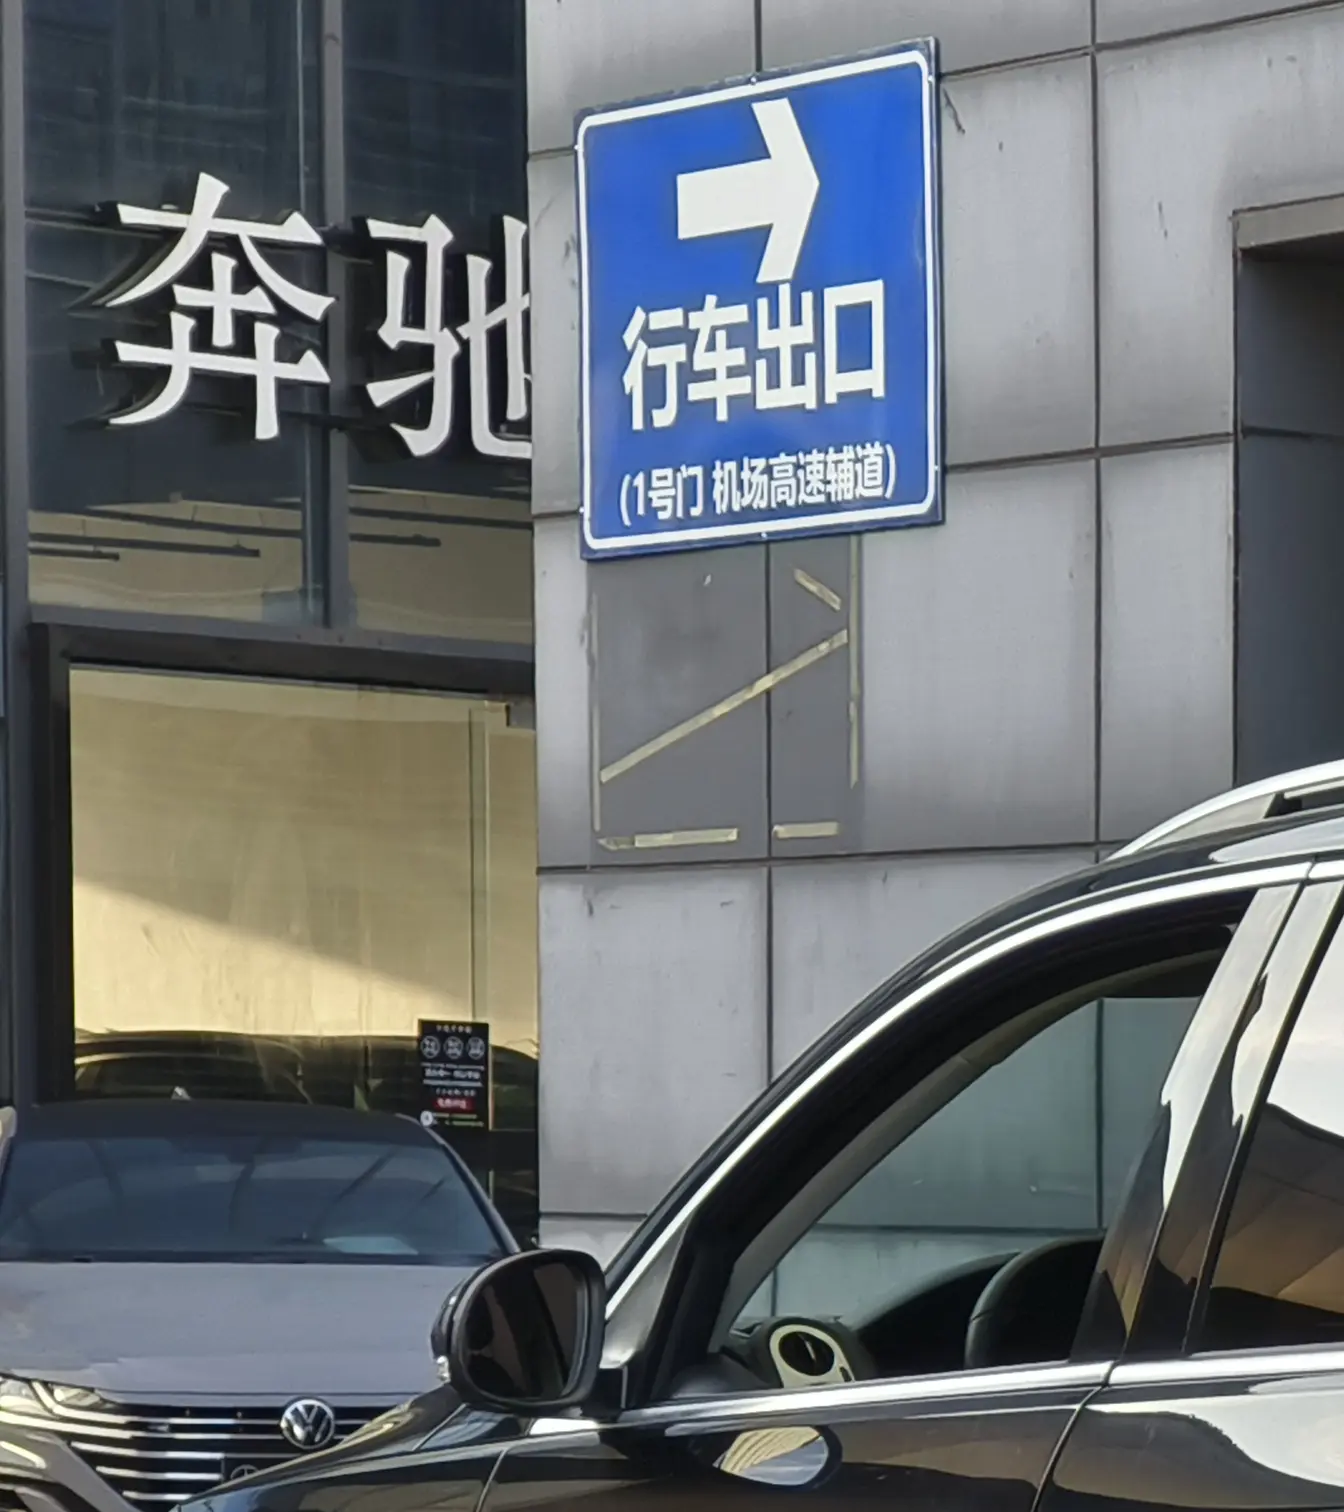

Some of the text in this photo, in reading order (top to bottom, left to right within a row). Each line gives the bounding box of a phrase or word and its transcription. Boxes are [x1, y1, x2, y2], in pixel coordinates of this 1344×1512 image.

[108, 171, 532, 460] 奔驰
[622, 279, 885, 431] 行车出口
[620, 441, 896, 526] (1号门 机场高速辅道)
